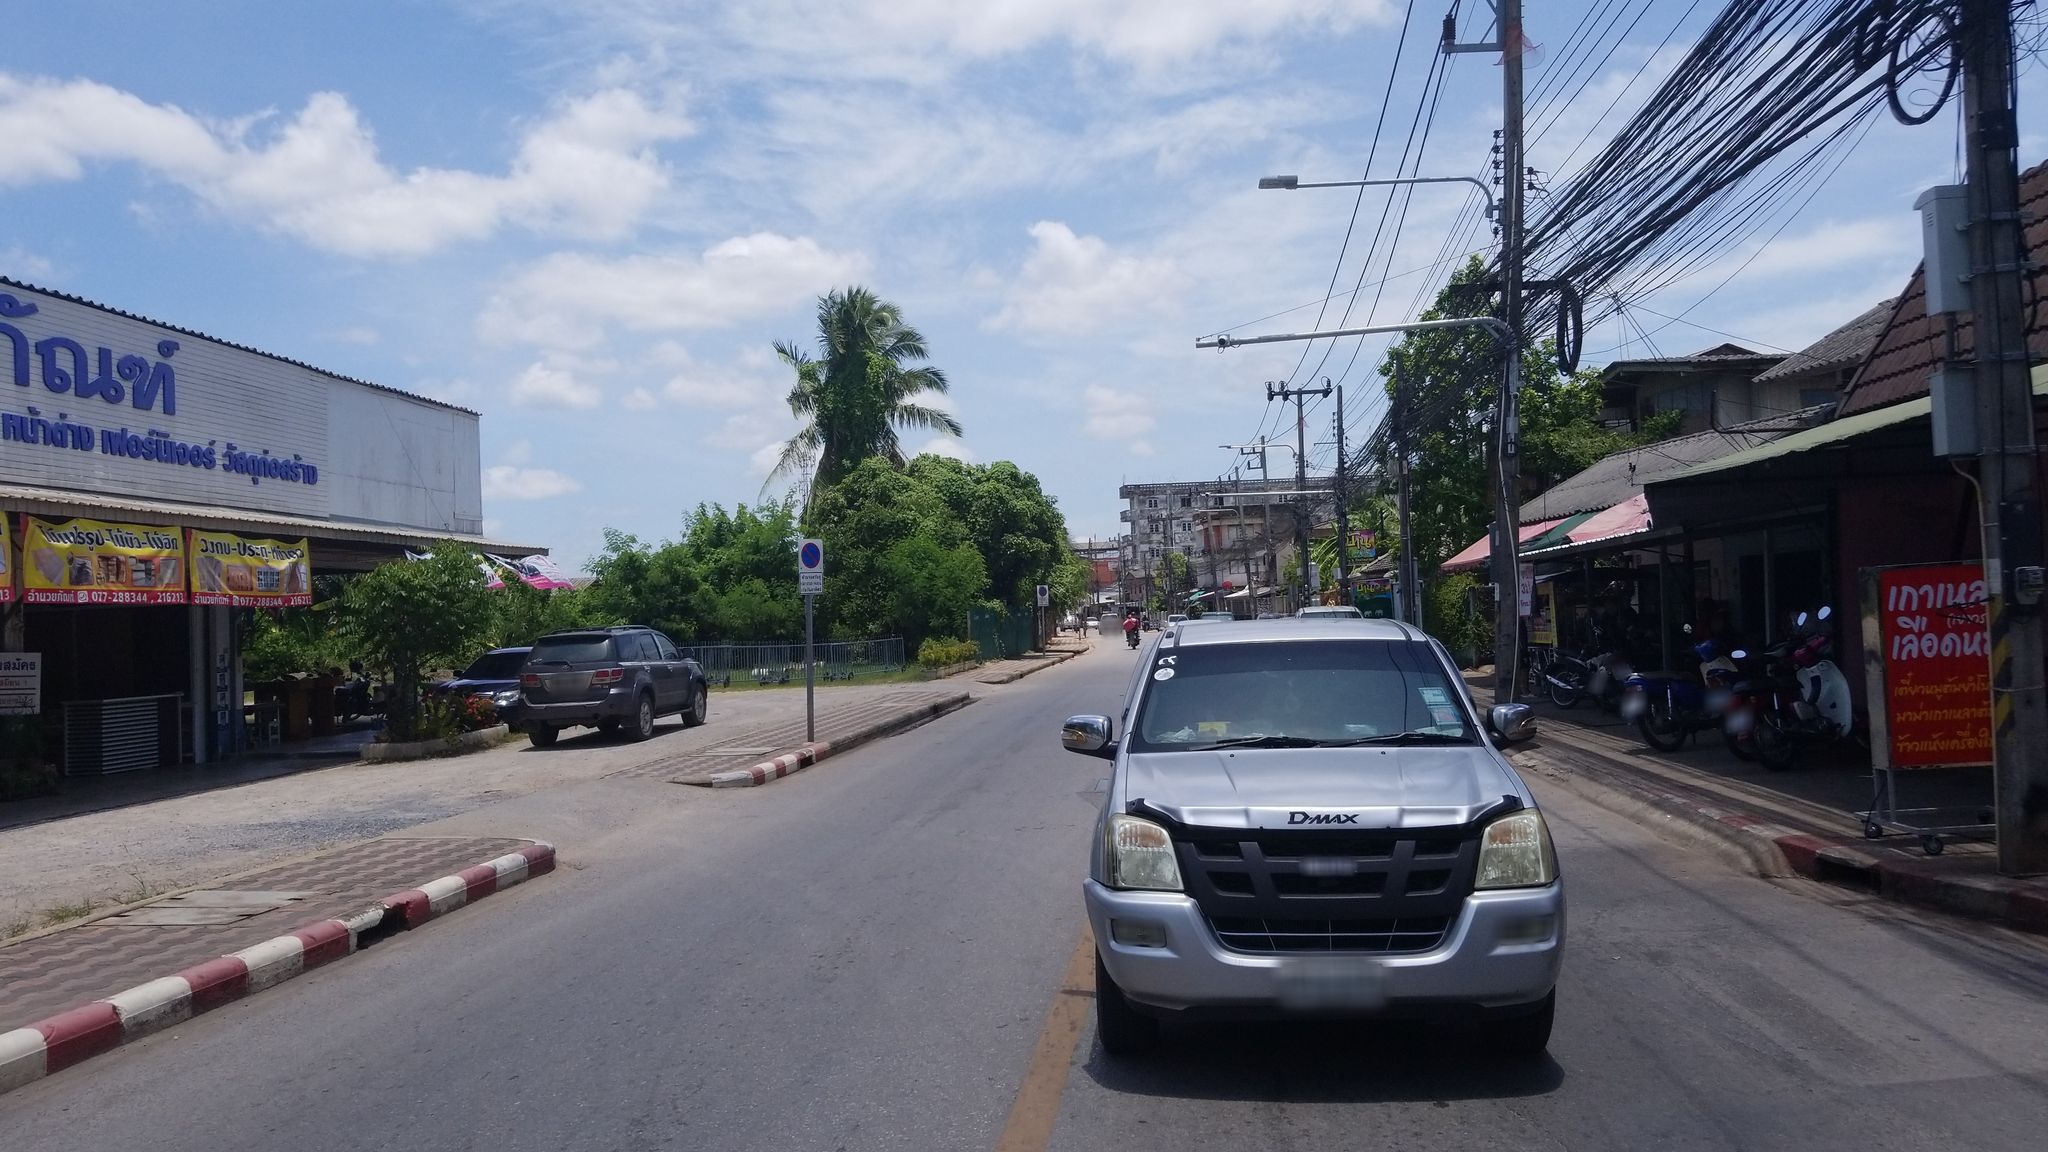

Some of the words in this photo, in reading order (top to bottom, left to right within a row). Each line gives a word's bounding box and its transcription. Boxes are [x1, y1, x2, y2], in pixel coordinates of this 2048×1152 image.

[2, 406, 95, 452] หน้าต่าง
[101, 428, 217, 470] เฟอร์นิเจอร์
[222, 443, 319, 485] วัสดุก่อสร้าง
[91, 591, 147, 603] 077-288344
[1287, 811, 1361, 825] D-MAX
